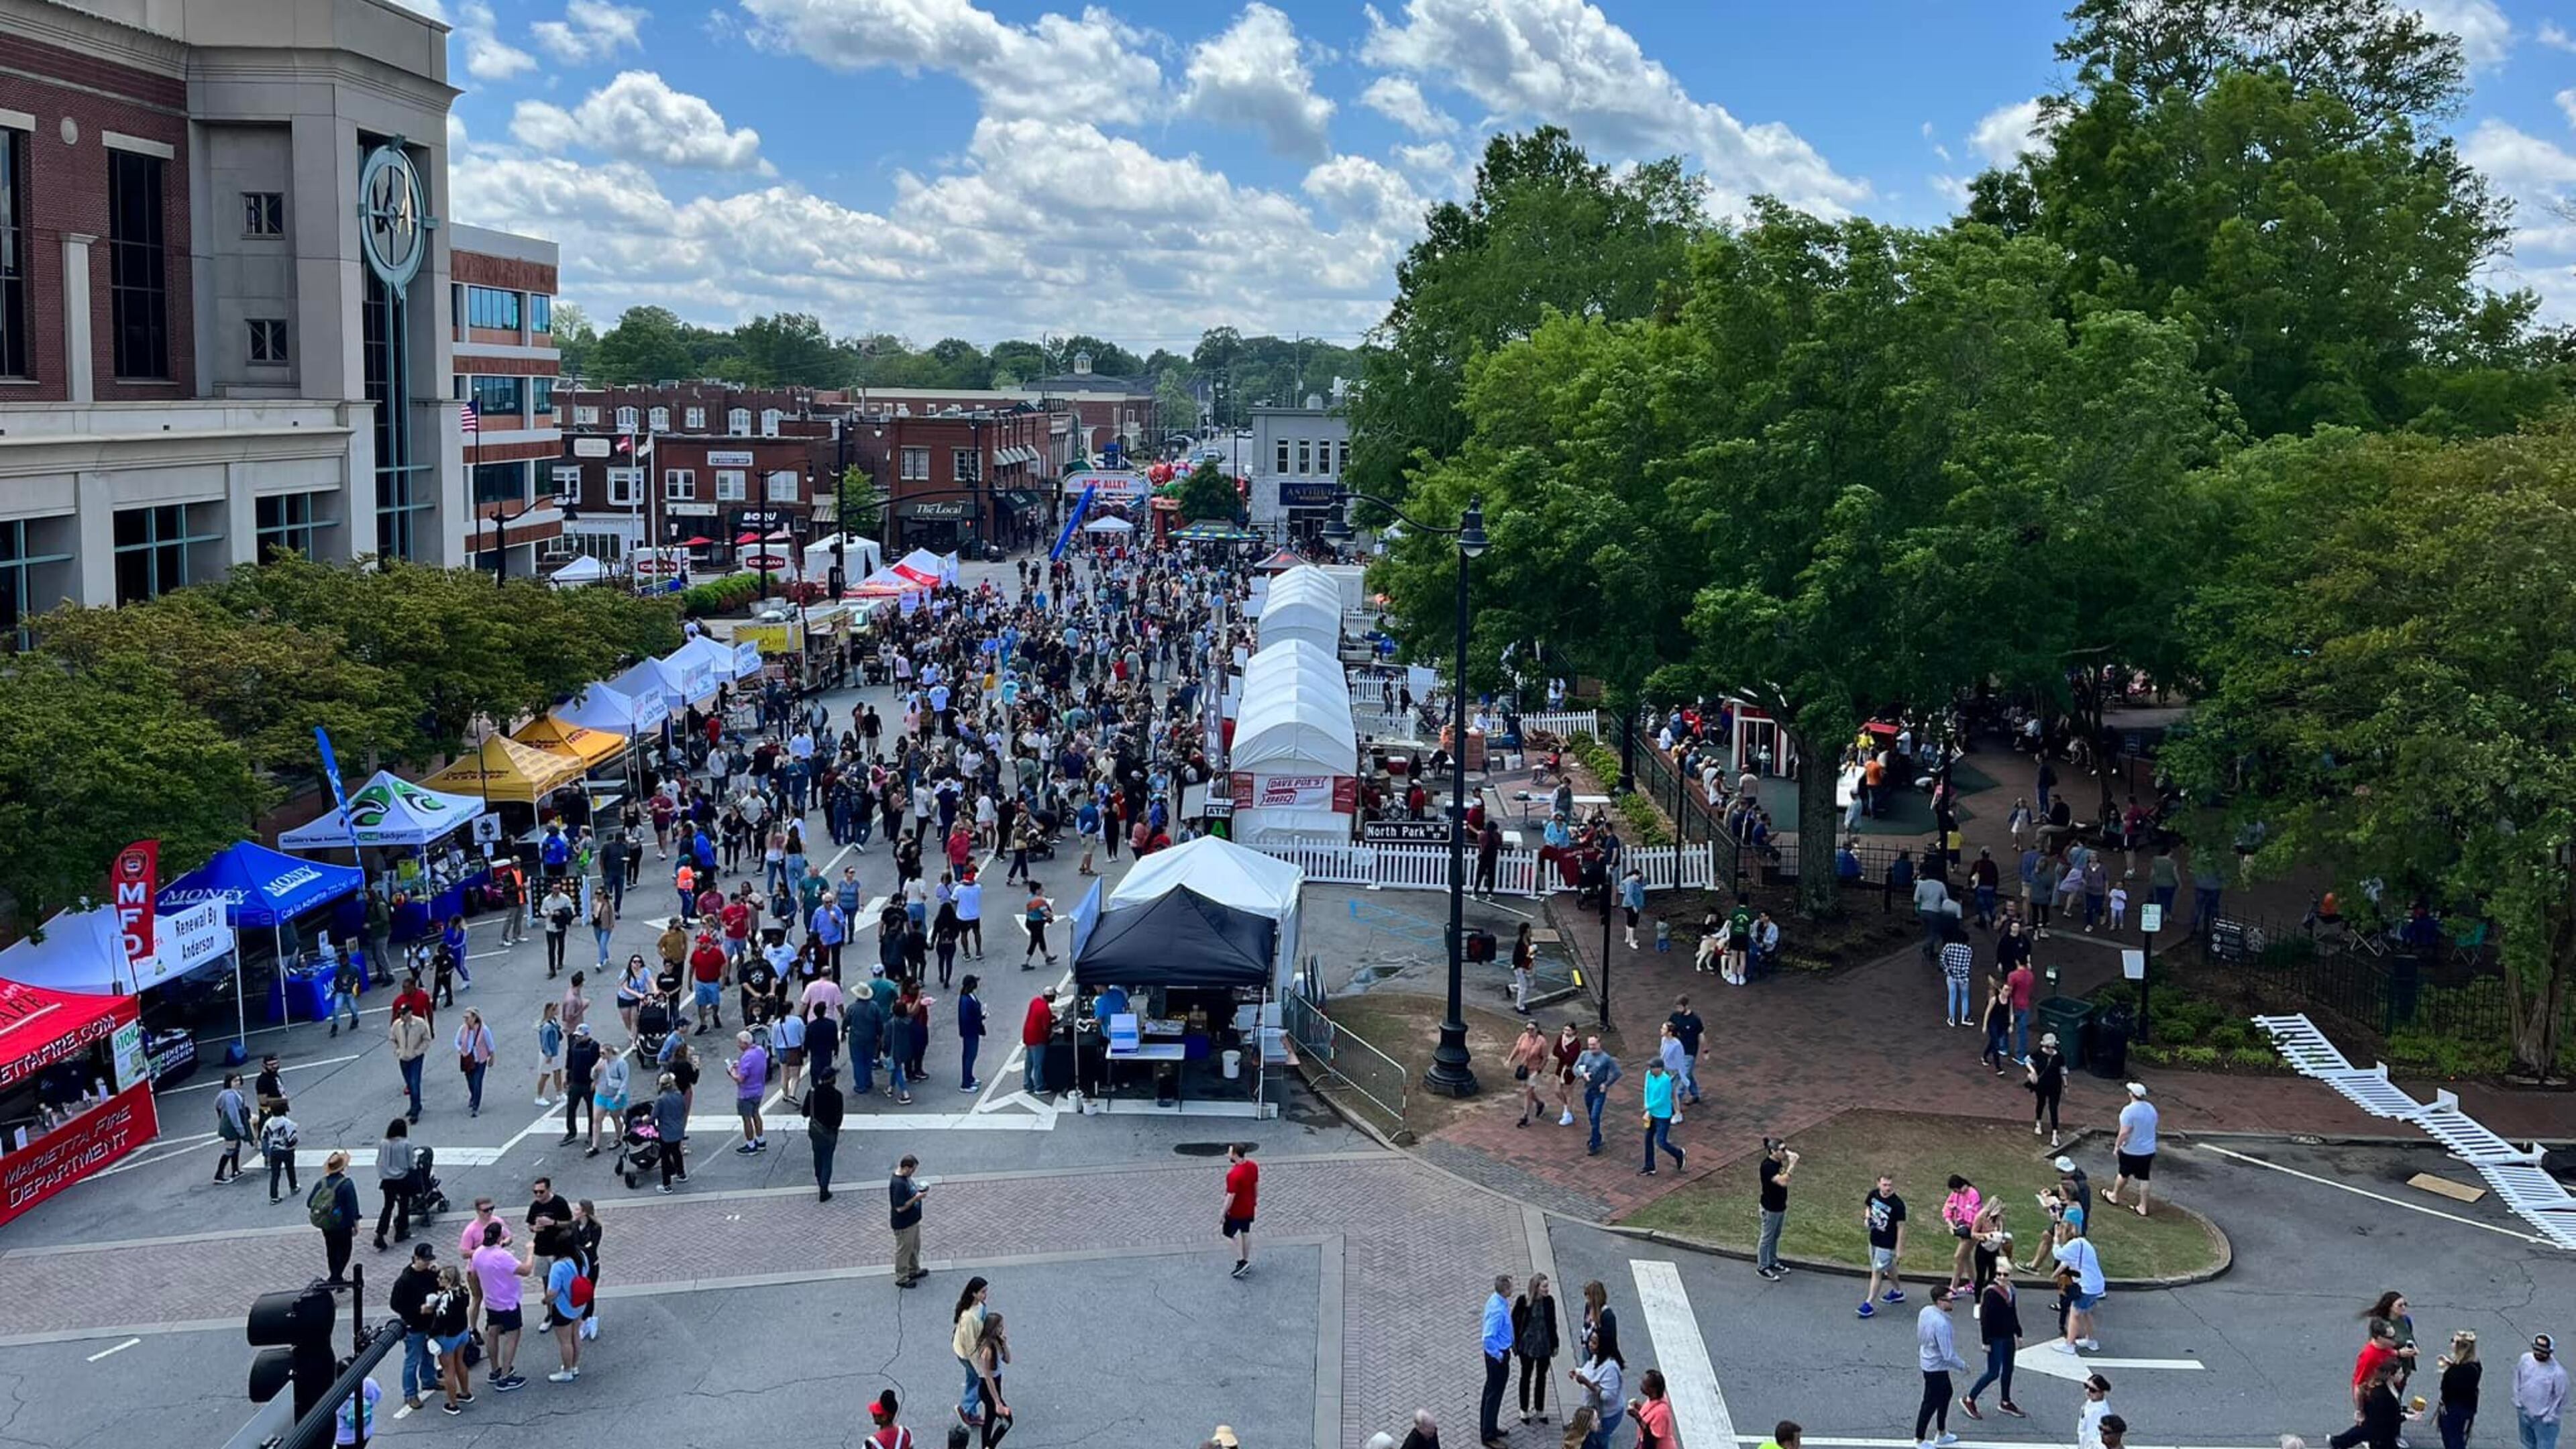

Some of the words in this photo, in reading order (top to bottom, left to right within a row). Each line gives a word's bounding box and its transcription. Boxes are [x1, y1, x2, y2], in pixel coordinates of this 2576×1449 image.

[1104, 479, 1128, 489] ALLEY
[916, 504, 935, 513] The
[936, 502, 963, 513] Local
[1271, 780, 1292, 788] DAVE
[1266, 795, 1292, 804] BBQ
[1208, 808, 1230, 816] ATM
[1367, 826, 1397, 837] North
[1402, 826, 1425, 837] Park
[380, 832, 408, 843] Badger
[262, 864, 317, 892] MONEY
[164, 888, 251, 903] MONEY
[175, 907, 207, 938] Renewal
[208, 905, 217, 926] By
[181, 934, 215, 962] Anderson
[3, 1129, 90, 1189] MARIETTA
[93, 1104, 131, 1138] FIRE
[9, 1128, 129, 1209] DEPARTMENT
